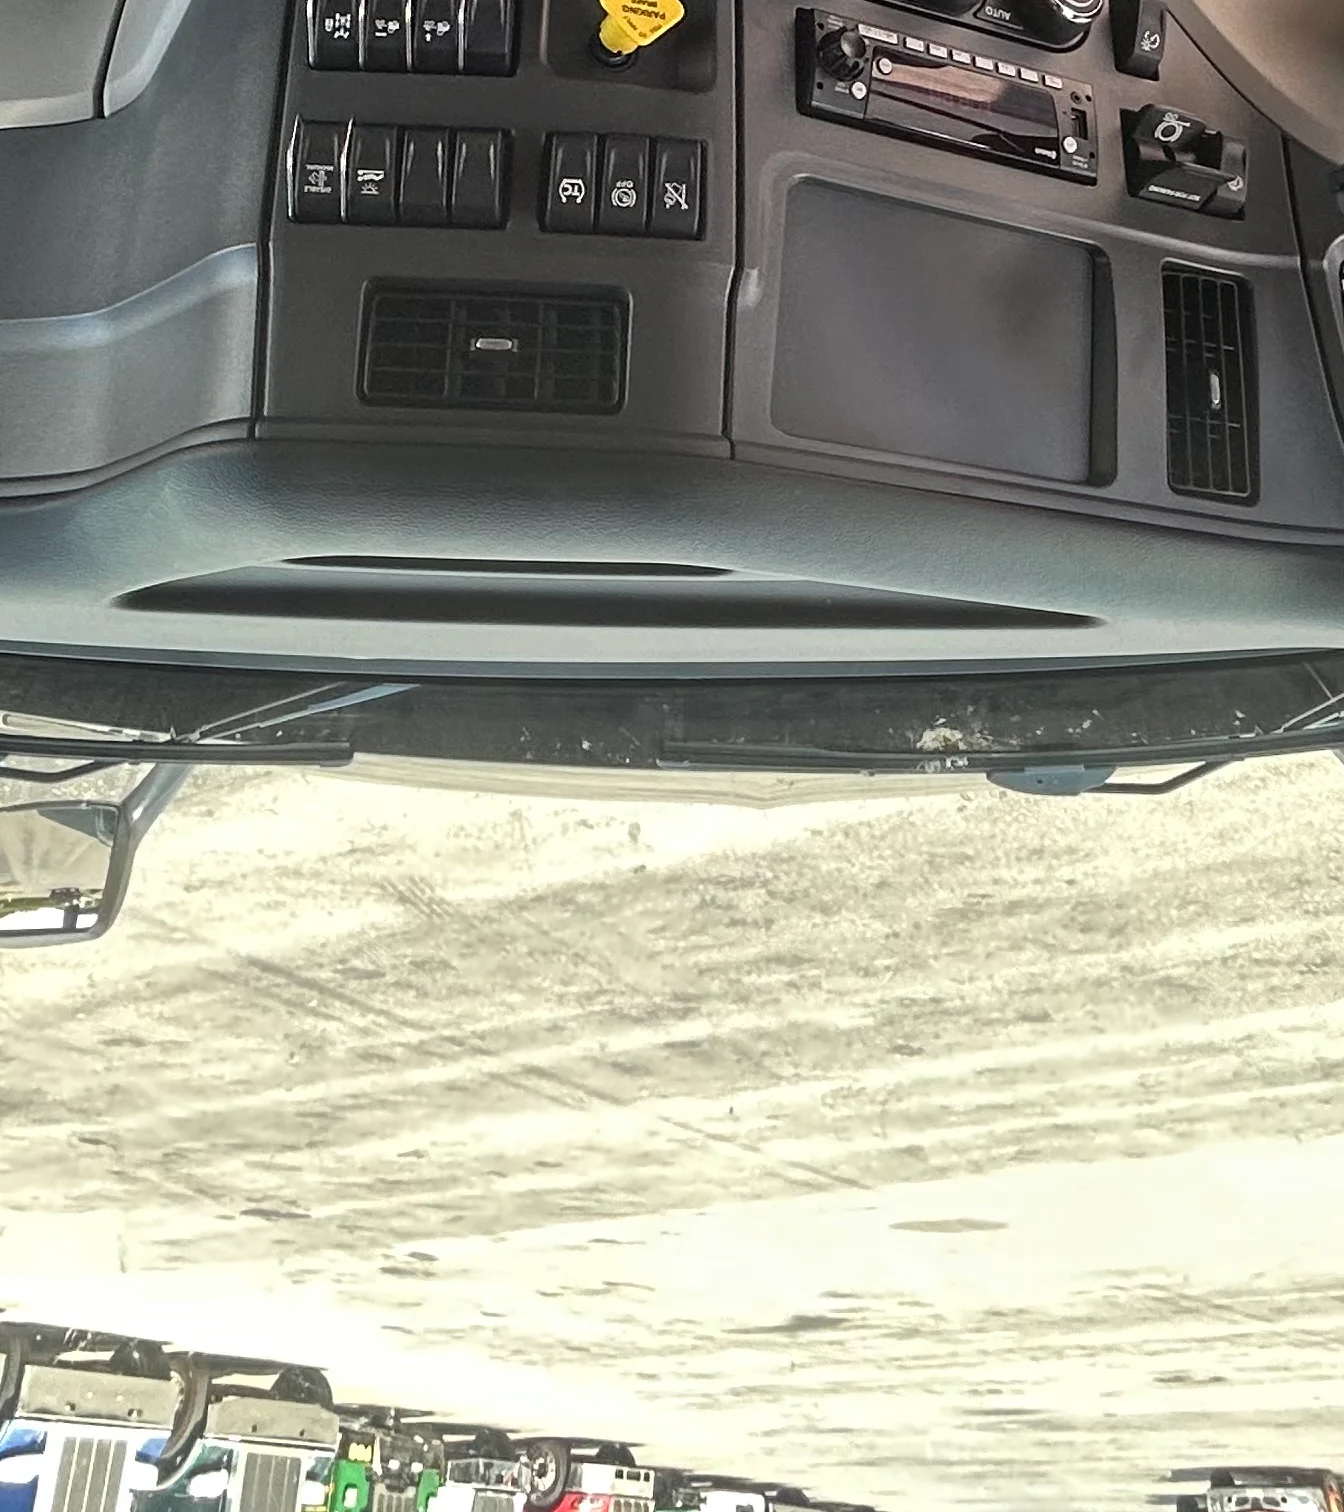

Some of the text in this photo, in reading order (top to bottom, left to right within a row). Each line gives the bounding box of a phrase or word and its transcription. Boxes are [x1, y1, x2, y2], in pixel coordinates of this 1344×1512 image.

[621, 5, 666, 20] PARKING
[985, 6, 1011, 21] AUTO
[563, 184, 580, 196] TC
[615, 180, 634, 188] OFF
